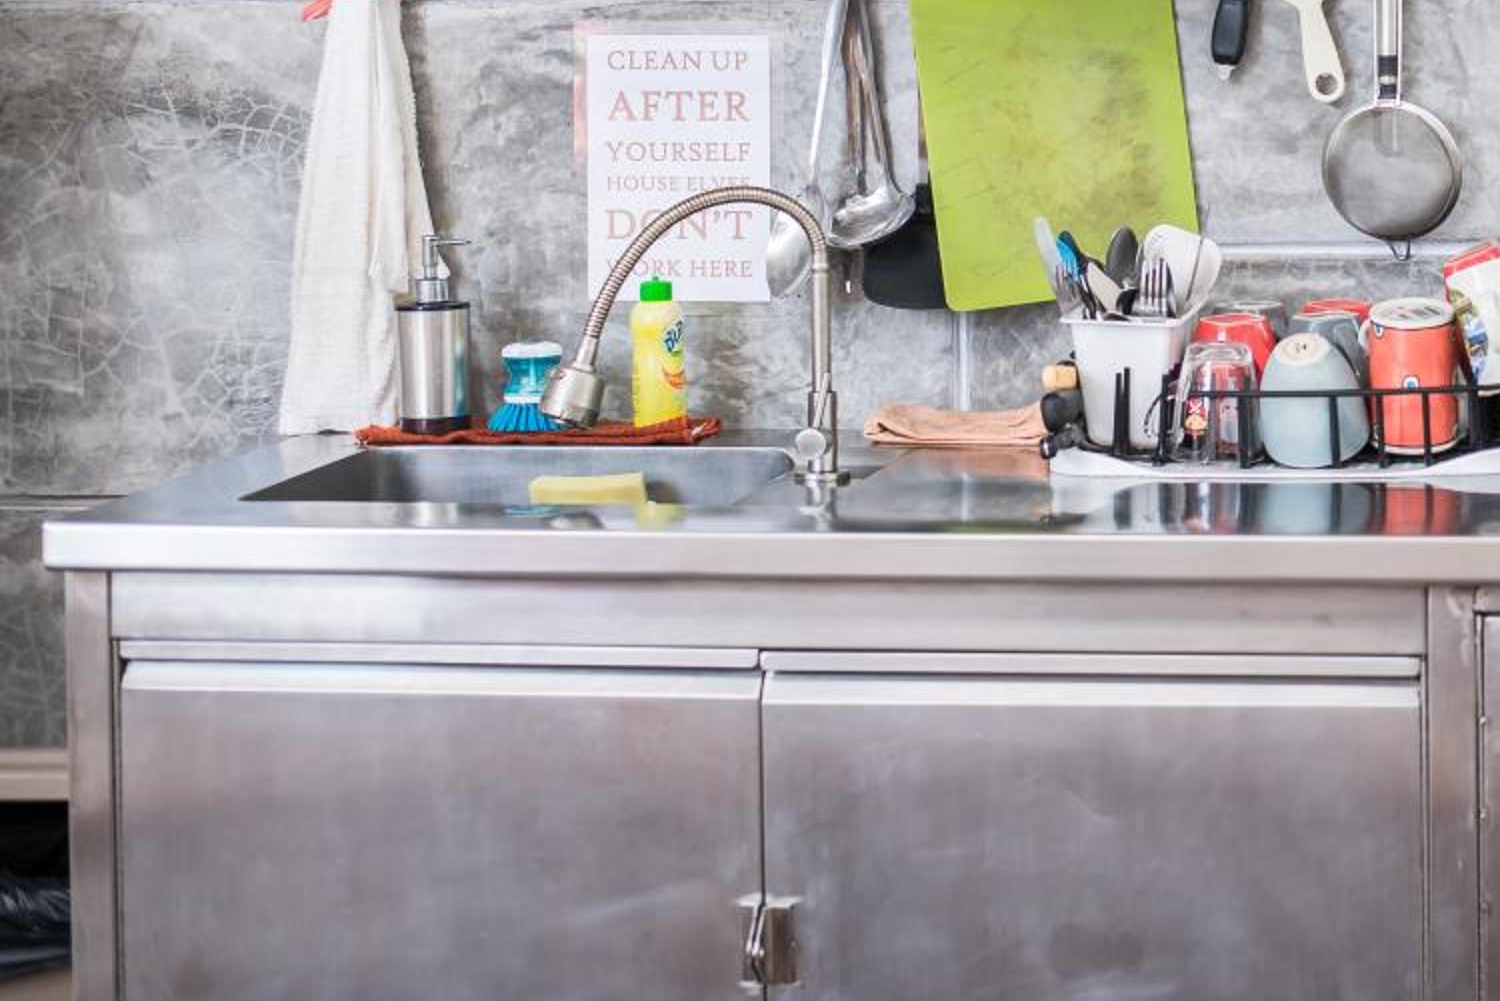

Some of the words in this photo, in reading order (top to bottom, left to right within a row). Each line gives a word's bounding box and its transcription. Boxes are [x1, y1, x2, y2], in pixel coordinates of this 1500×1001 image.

[607, 50, 701, 70] CLEAN
[713, 51, 748, 70] UP
[608, 91, 750, 121] AFTER
[605, 142, 751, 162] YOURSELF
[607, 176, 680, 192] HOUSE
[606, 259, 682, 278] ORK
[690, 260, 752, 278] HERE
